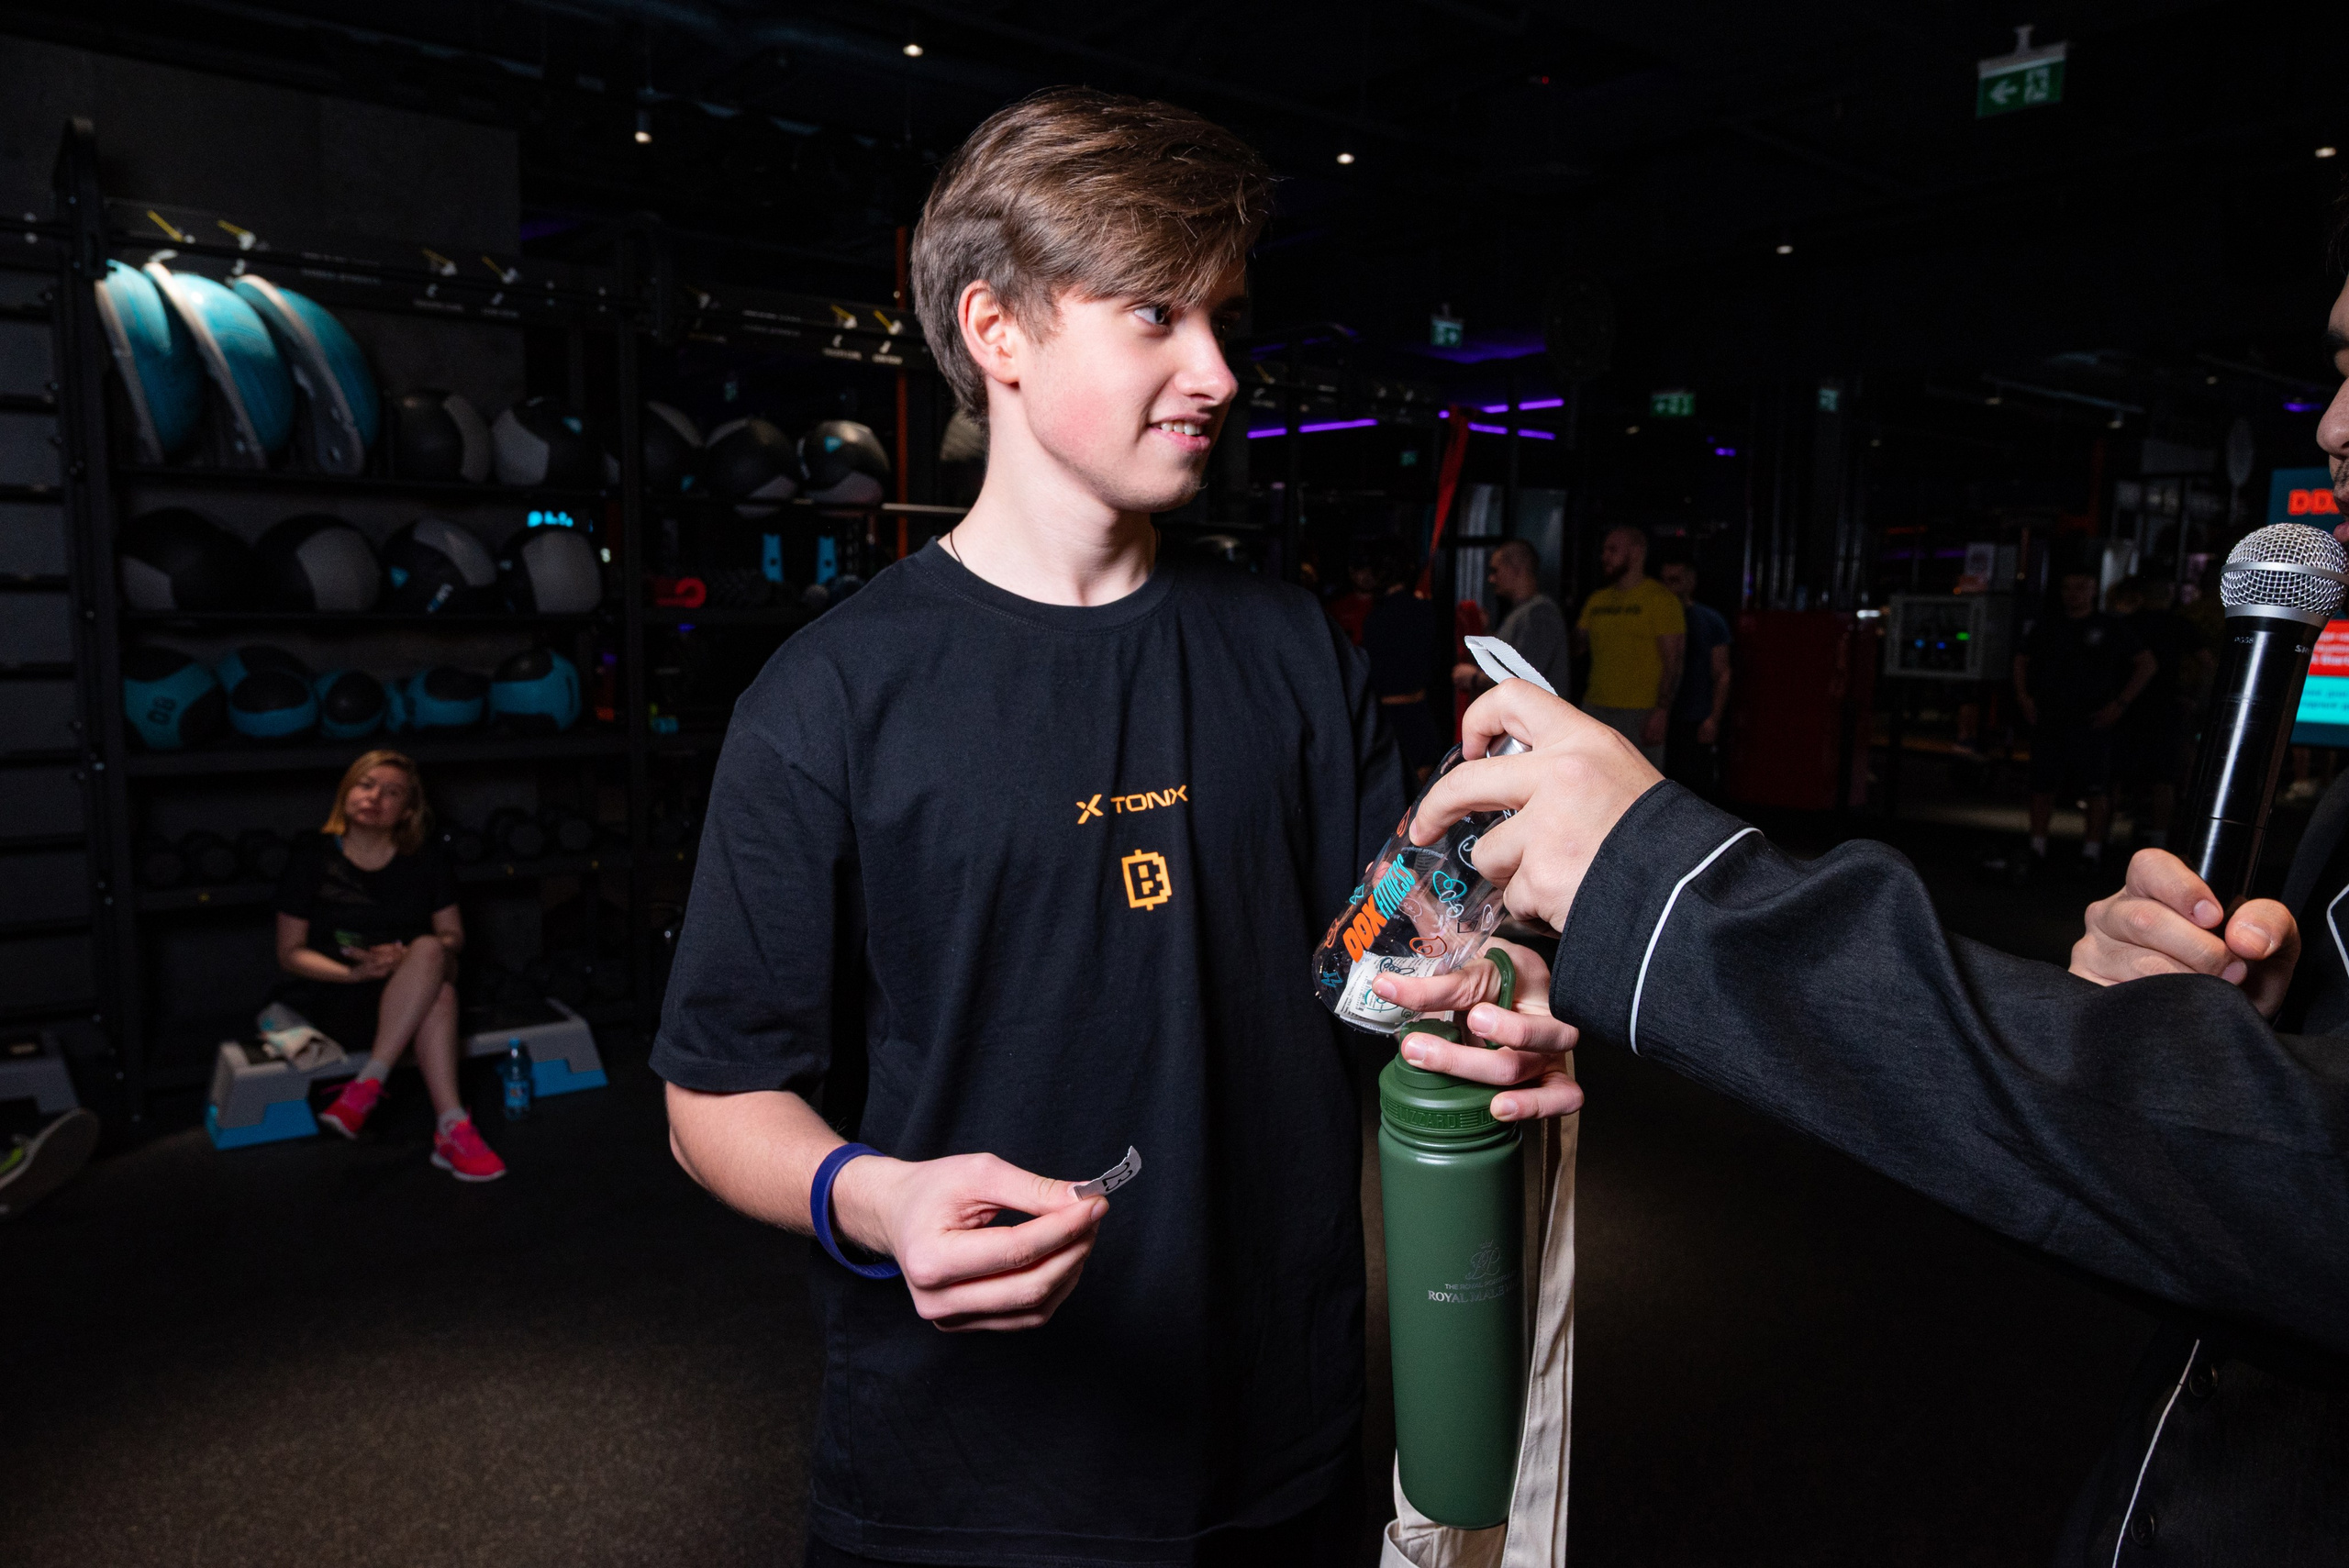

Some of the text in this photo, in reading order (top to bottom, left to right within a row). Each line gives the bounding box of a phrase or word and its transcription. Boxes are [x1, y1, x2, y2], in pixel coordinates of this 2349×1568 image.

[1110, 784, 1189, 814] TONX
[1342, 894, 1388, 963] DDX
[1373, 853, 1416, 920] FITNESS
[1398, 1106, 1457, 1129] LIZZARD
[1428, 1290, 1468, 1303] ROYAL
